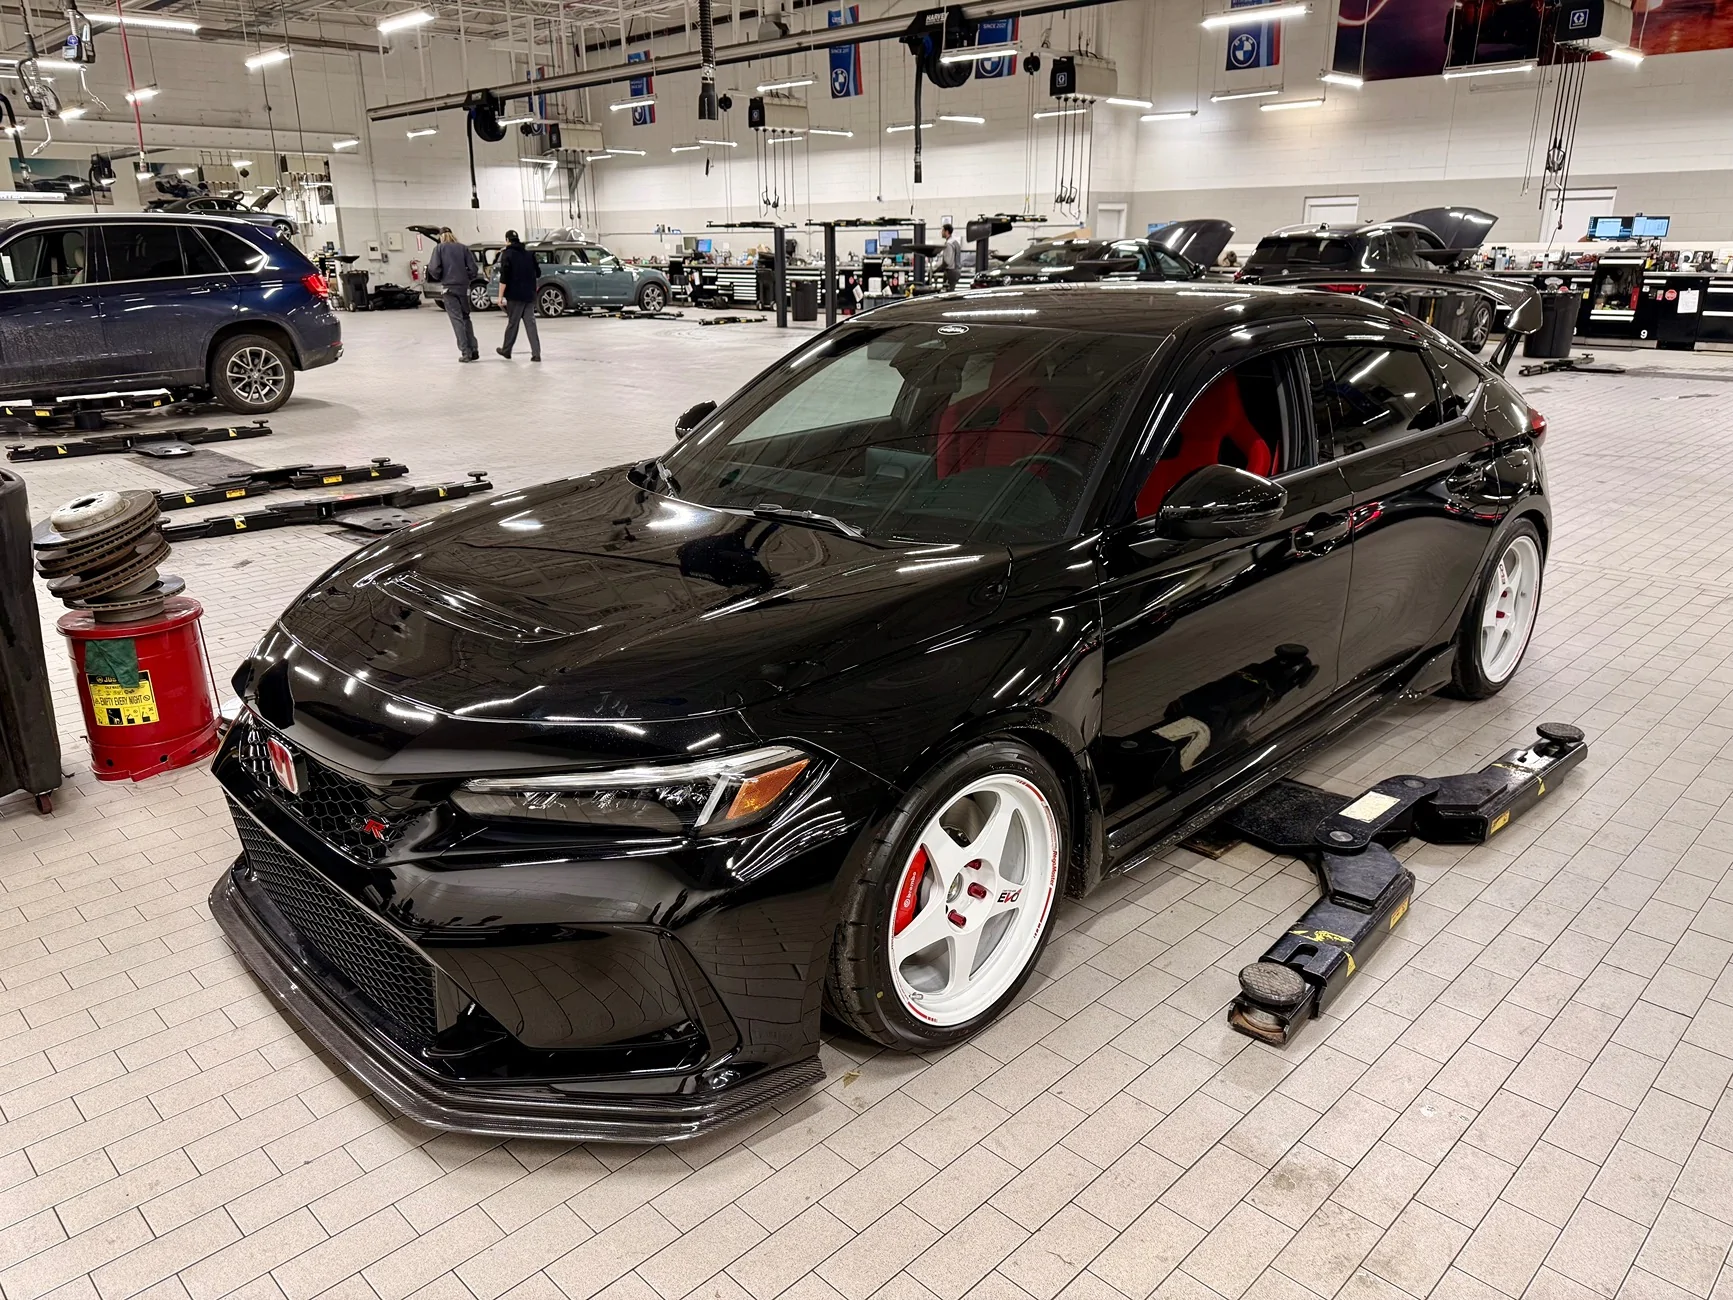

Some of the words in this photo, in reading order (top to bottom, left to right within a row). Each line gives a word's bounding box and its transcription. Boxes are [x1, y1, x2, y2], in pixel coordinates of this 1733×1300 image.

[1640, 329, 1648, 339] 9
[99, 697, 113, 706] EMPTY
[114, 696, 128, 706] EVERY
[128, 695, 143, 705] NIGHT
[906, 872, 917, 898] brembo
[997, 888, 1022, 903] EVO
